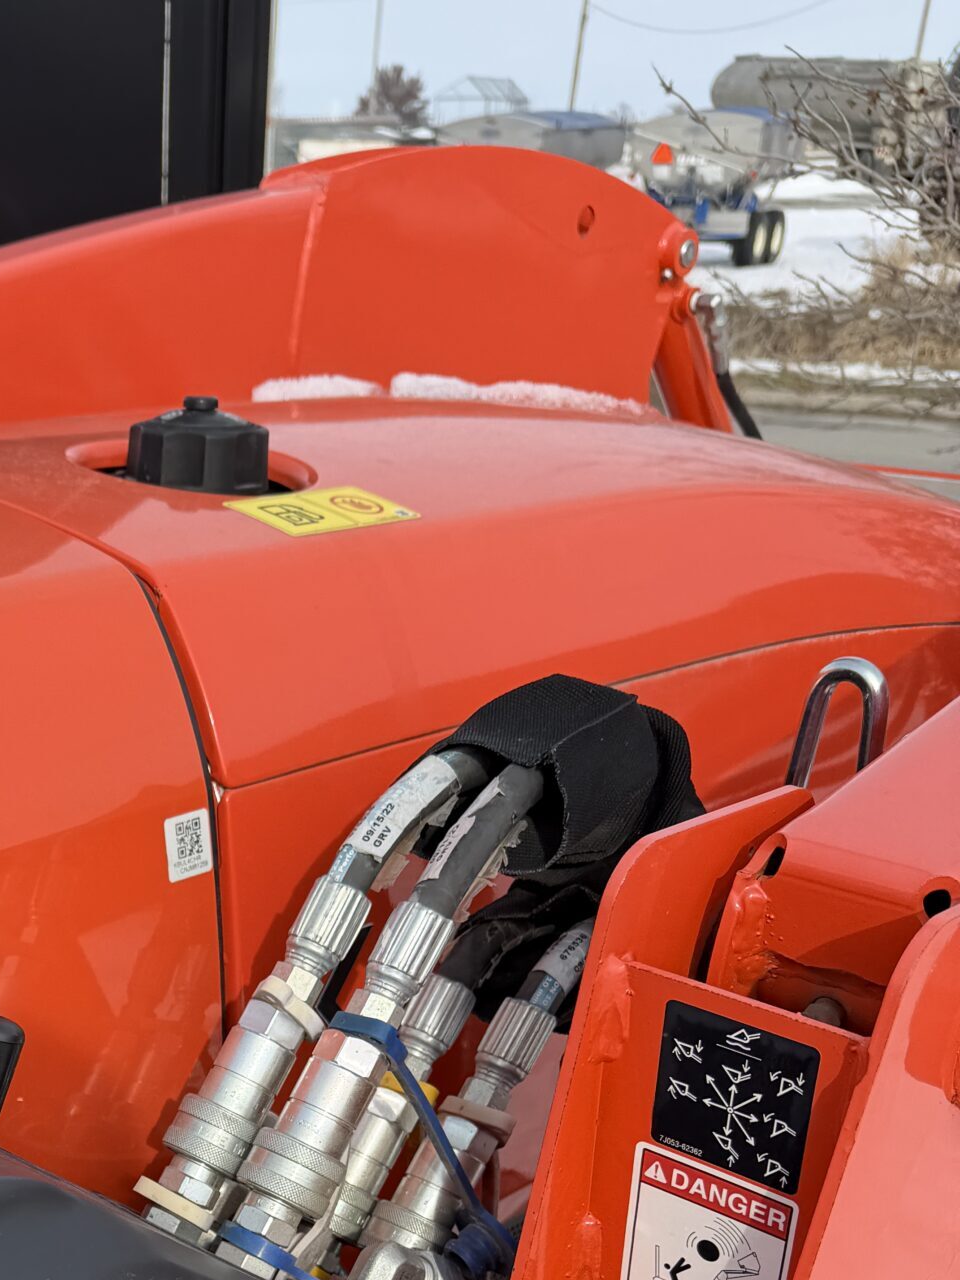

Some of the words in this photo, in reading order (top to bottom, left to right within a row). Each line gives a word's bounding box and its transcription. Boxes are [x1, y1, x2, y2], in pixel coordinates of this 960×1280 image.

[362, 802, 395, 842] 09/15/22
[373, 826, 392, 848] GRV
[659, 1134, 702, 1157] 7J053-62362
[670, 1168, 786, 1232] DANGER
